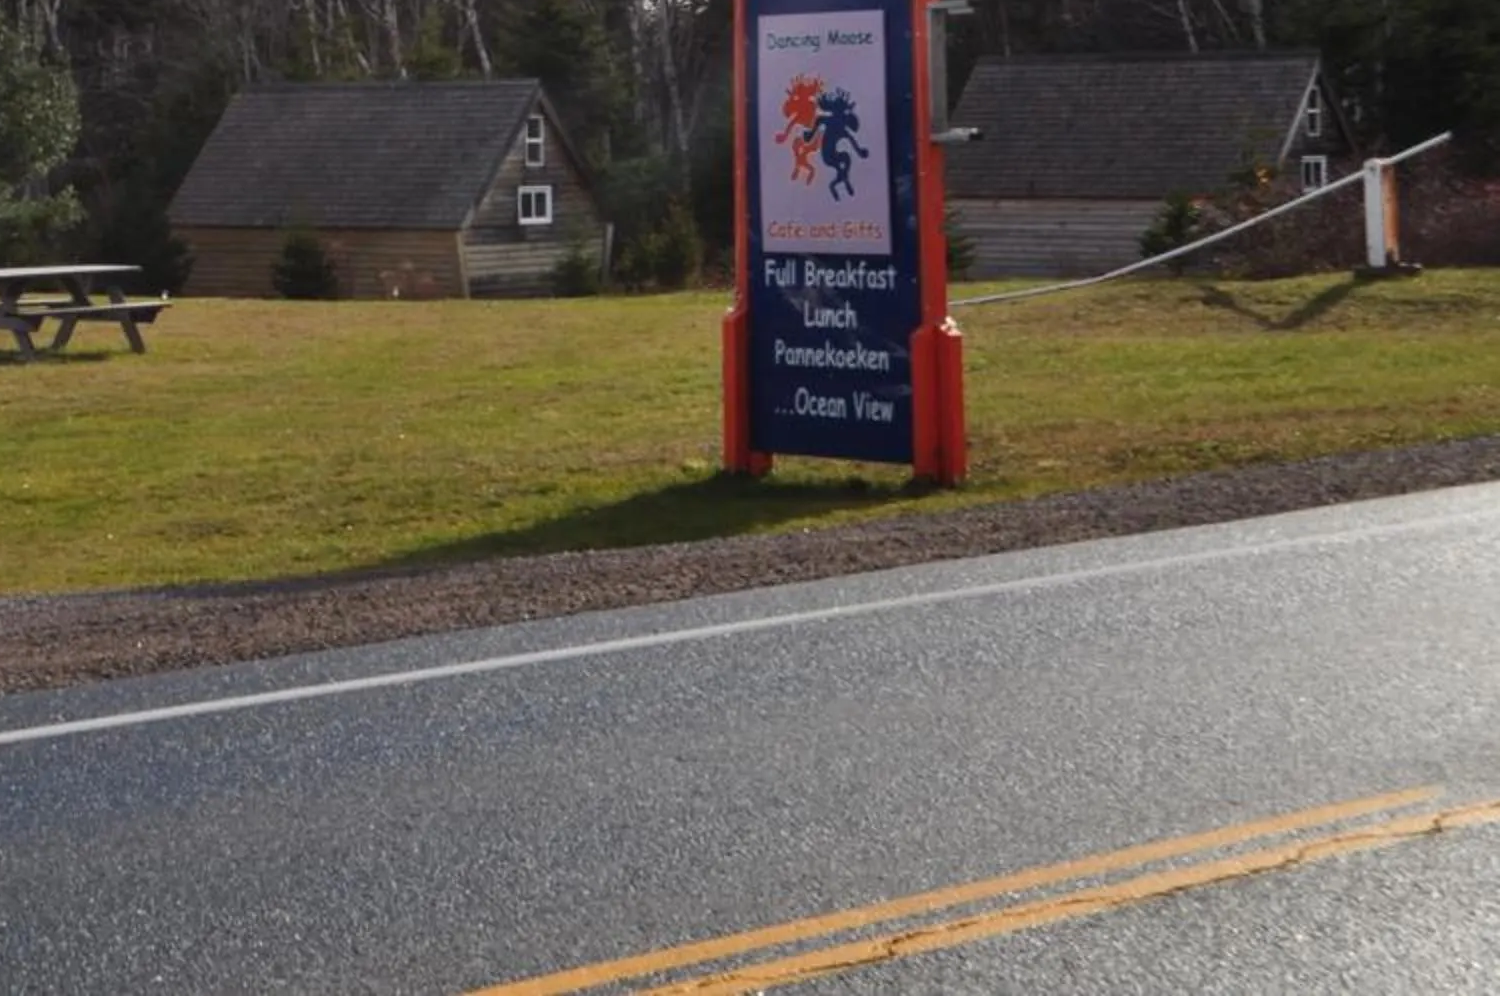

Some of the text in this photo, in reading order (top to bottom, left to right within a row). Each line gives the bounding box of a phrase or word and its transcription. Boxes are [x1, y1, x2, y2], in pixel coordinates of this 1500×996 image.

[767, 29, 874, 53] Dancing Moose
[809, 221, 837, 239] and
[842, 221, 883, 241] Gifts
[764, 259, 897, 289] Full Breakfast
[803, 301, 858, 329] Lunch
[774, 338, 890, 371] Pannekoeken
[852, 391, 894, 422] View
